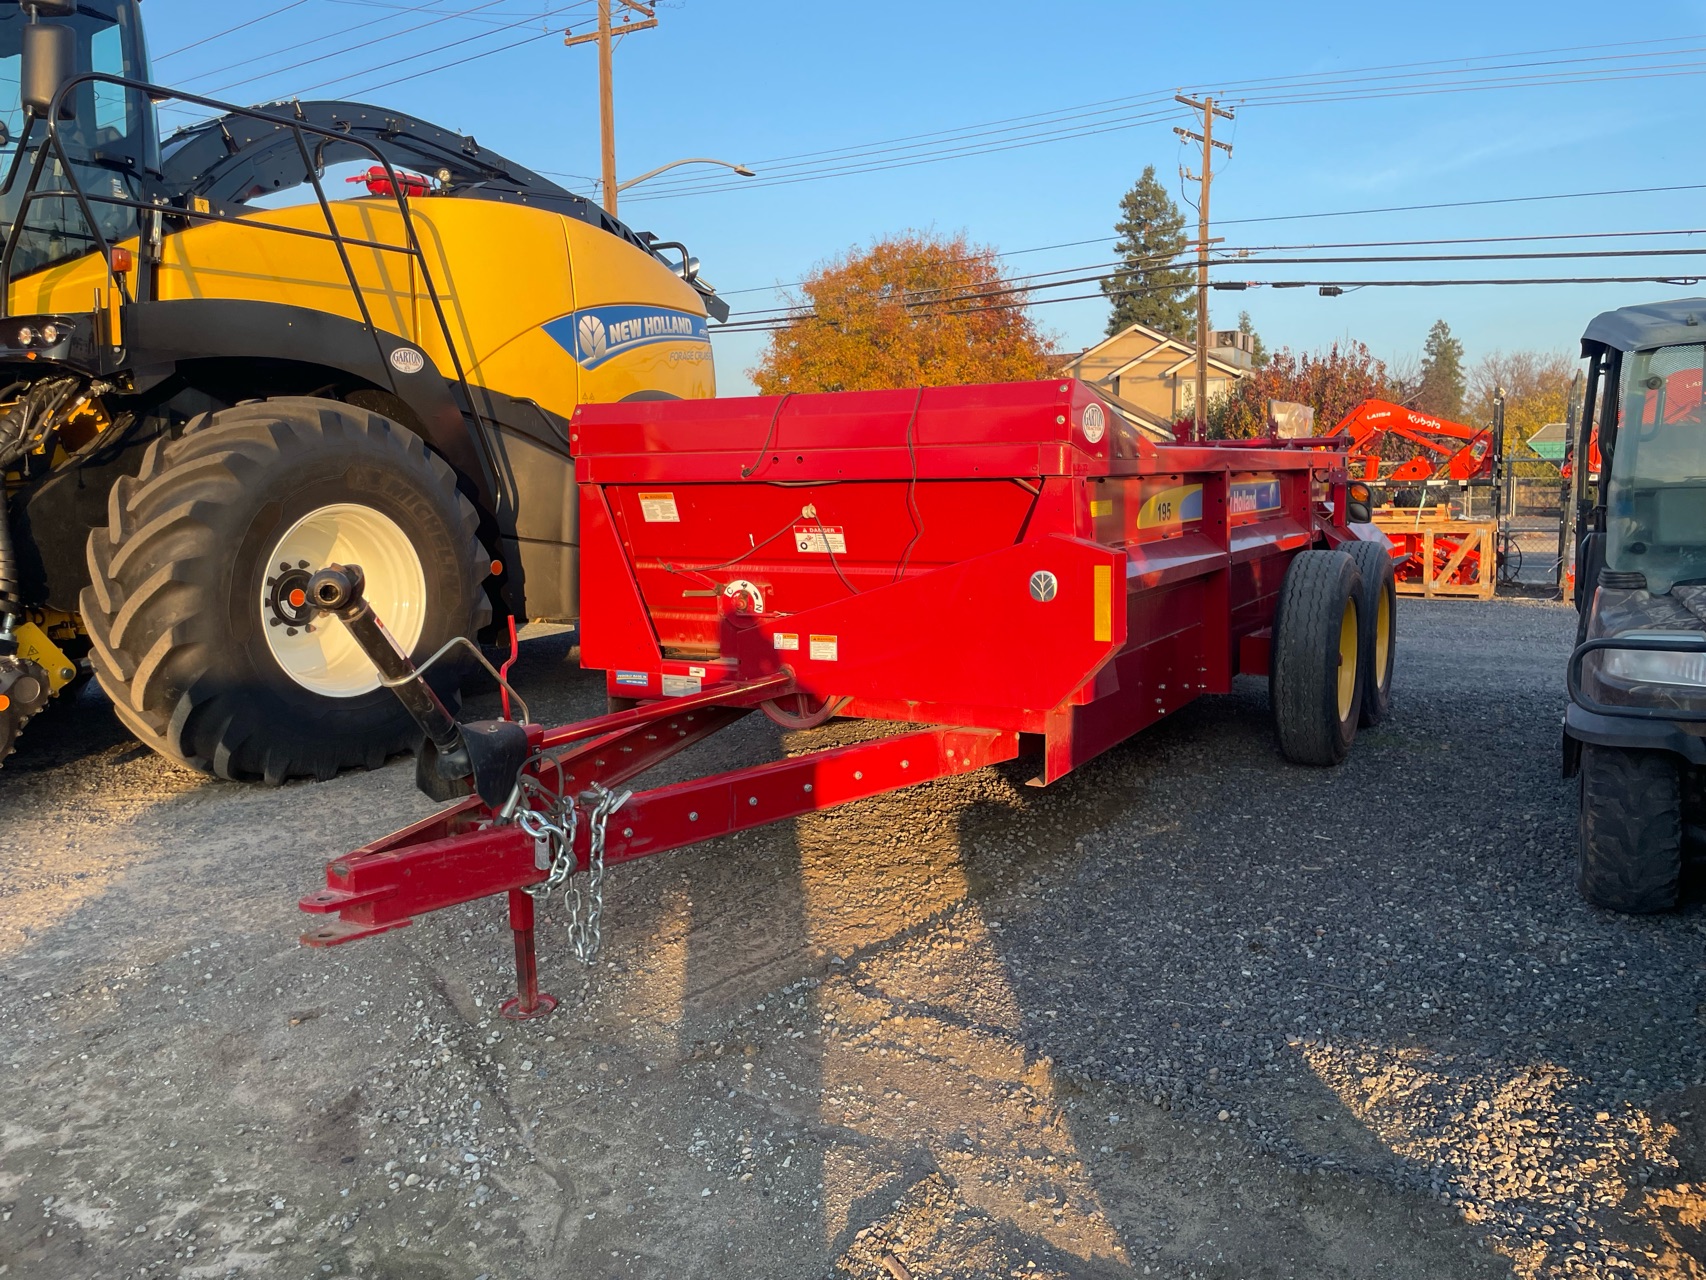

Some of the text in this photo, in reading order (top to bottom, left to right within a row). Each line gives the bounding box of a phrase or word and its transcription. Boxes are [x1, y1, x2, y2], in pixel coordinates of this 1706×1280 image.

[609, 315, 693, 345] NEW HOLLAND
[394, 351, 421, 364] GARTON
[669, 351, 694, 362] FORAGE
[1084, 408, 1103, 427] GARTON
[1407, 413, 1441, 429] Kubota
[1233, 488, 1257, 512] Holland
[1157, 502, 1171, 521] 195
